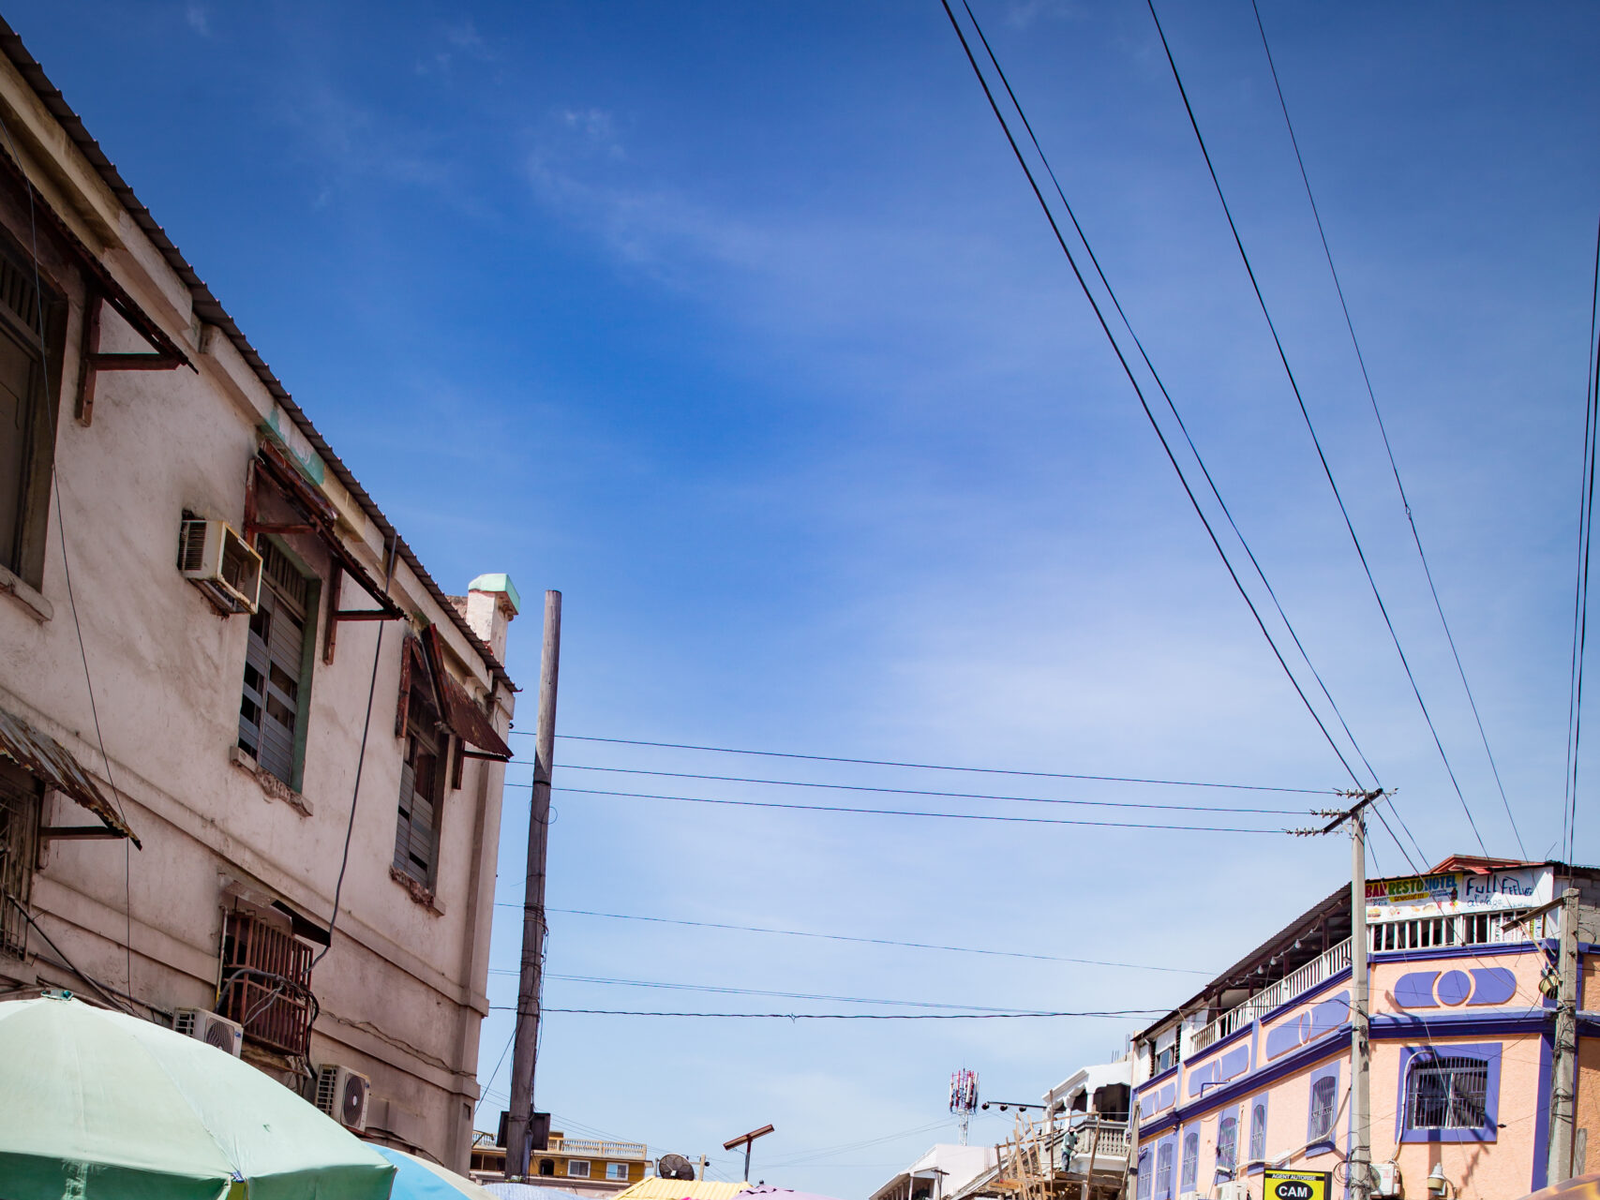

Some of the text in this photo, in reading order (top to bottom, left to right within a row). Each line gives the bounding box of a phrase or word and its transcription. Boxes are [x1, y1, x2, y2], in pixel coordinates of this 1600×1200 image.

[1365, 883, 1386, 898] BAR
[1388, 879, 1424, 895] RESTO
[1424, 875, 1457, 891] HOTEL
[1278, 1185, 1308, 1198] CAM
